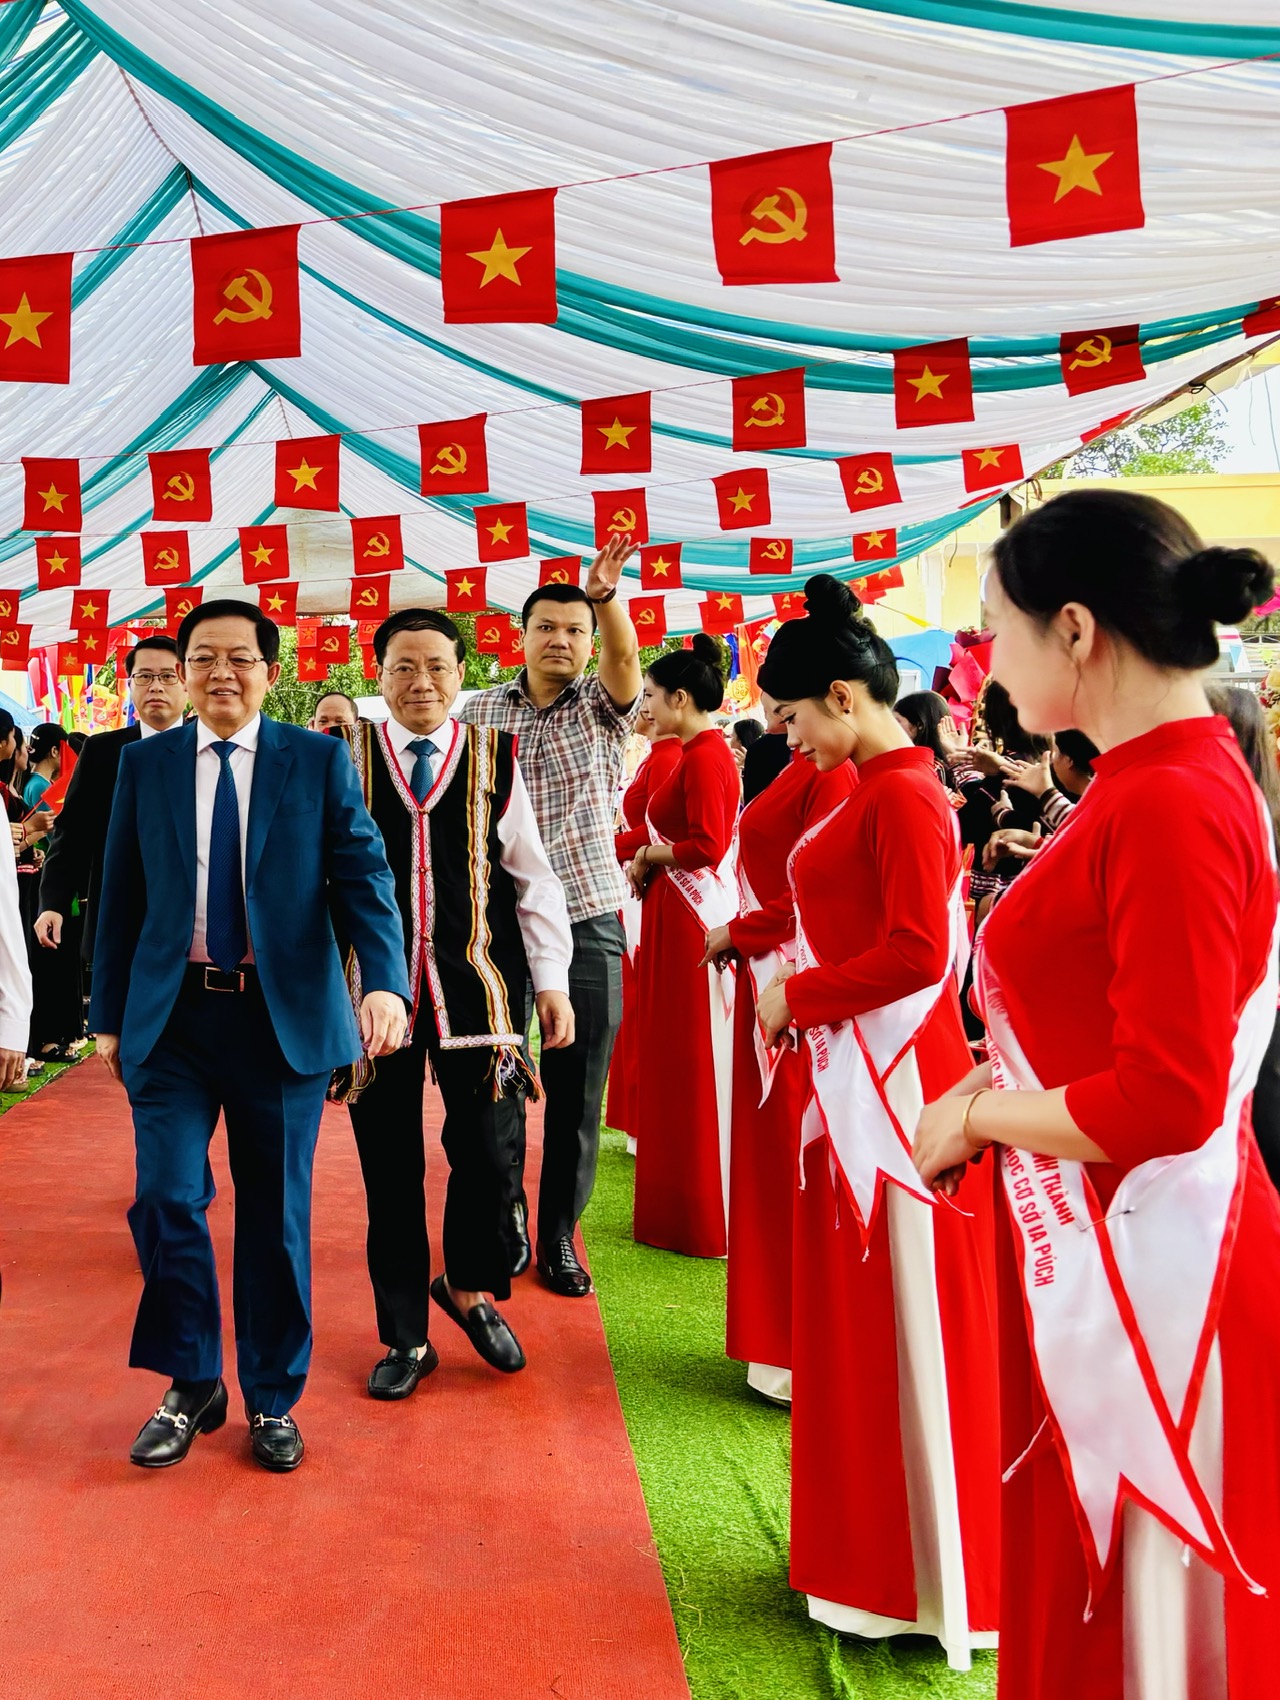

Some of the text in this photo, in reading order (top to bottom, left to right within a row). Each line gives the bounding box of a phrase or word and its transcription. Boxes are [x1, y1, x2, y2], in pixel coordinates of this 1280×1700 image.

[815, 1038, 826, 1052] IA
[1013, 1177, 1036, 1201] CƠ
[1040, 1172, 1076, 1226] THÀNH
[1018, 1201, 1046, 1224] SỞ
[1027, 1224, 1048, 1244] IA
[1034, 1242, 1058, 1288] PÚCH
